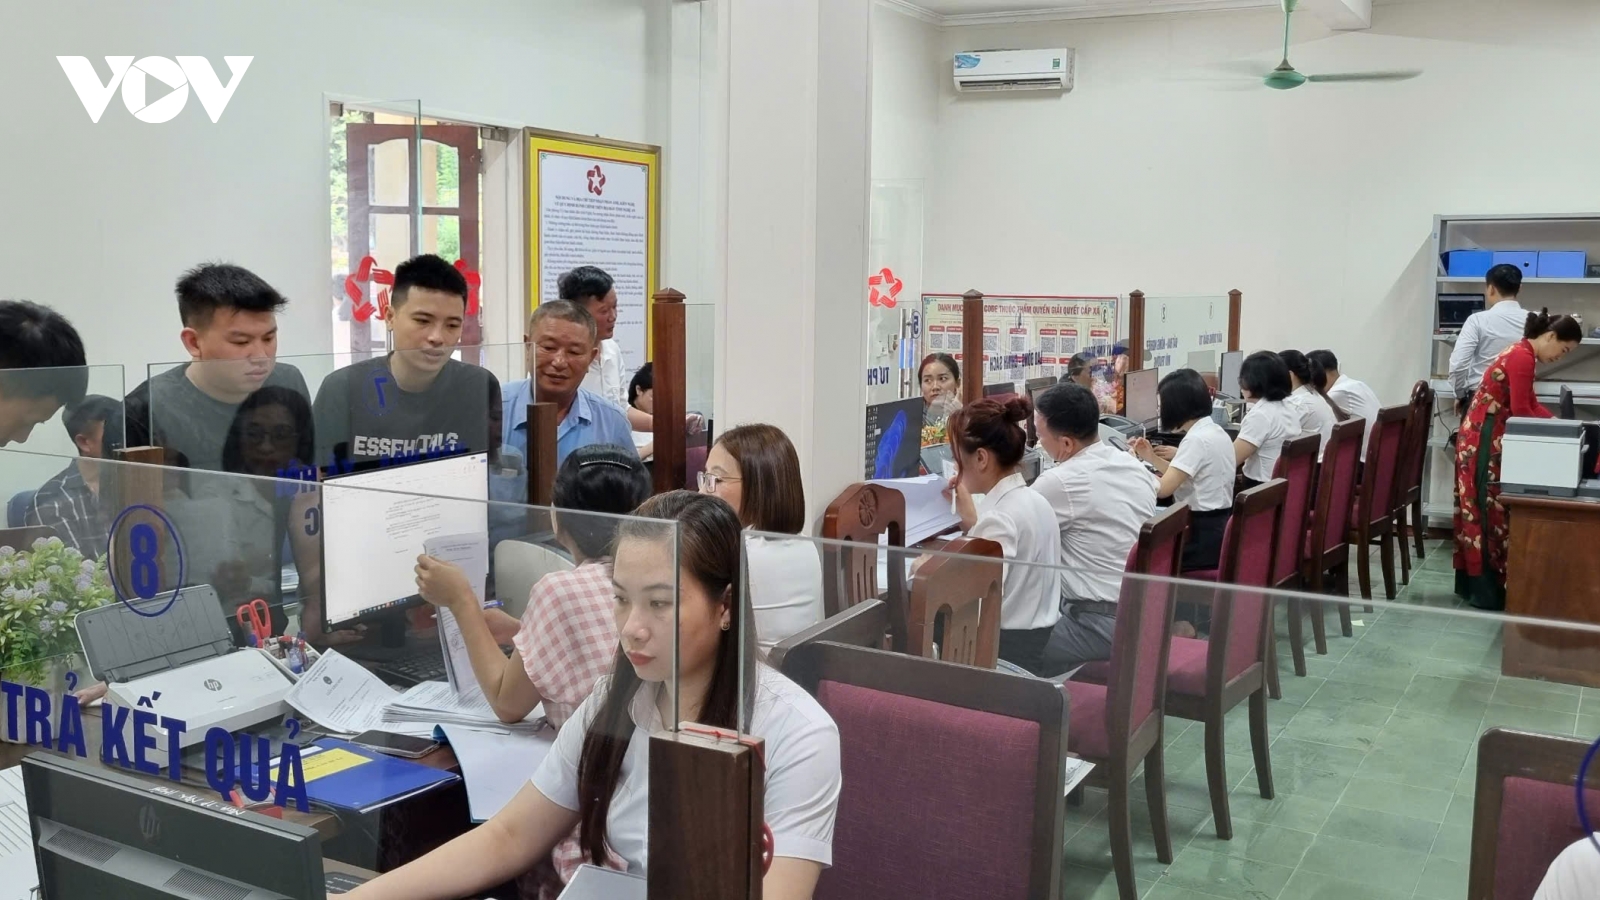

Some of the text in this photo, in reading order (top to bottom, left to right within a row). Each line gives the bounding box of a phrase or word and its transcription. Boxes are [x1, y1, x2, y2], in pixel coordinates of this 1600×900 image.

[129, 523, 160, 600] 8
[1, 672, 310, 813] TRẢ KẾT QUẢ
